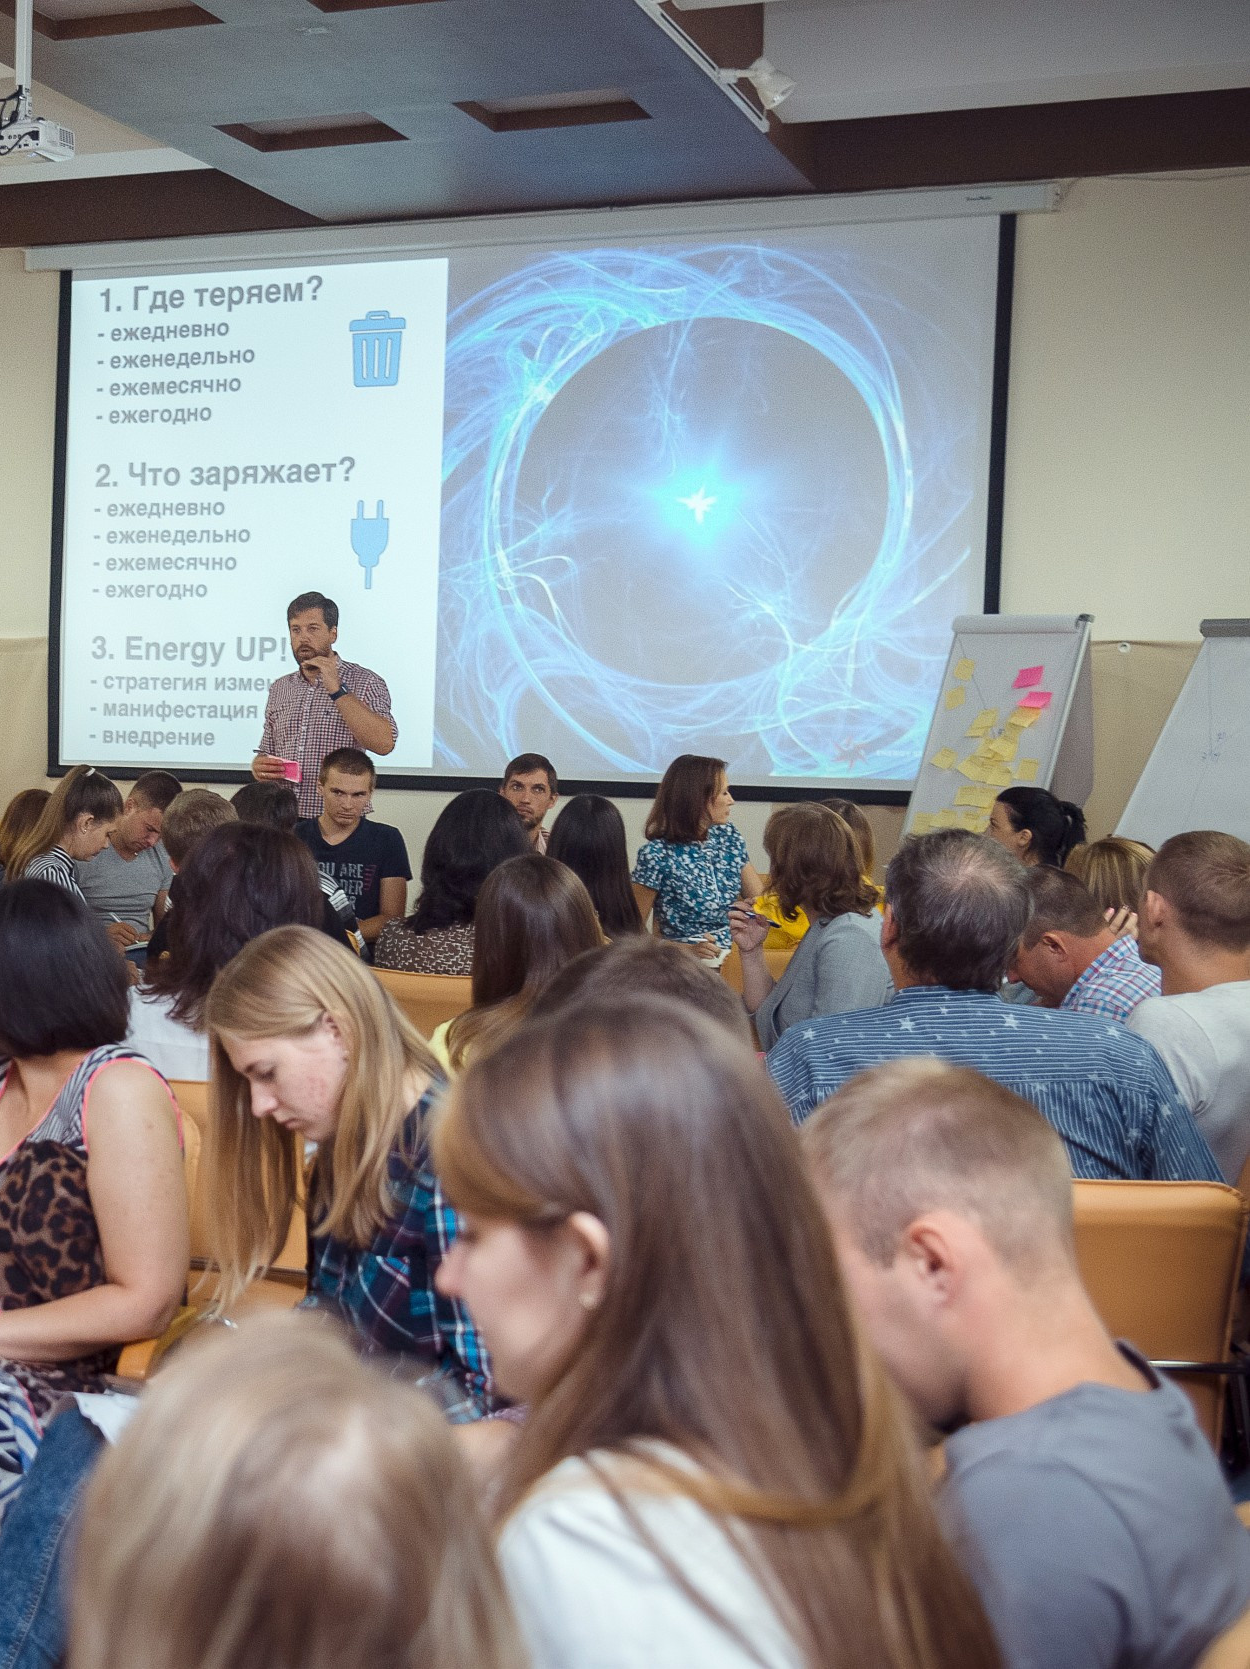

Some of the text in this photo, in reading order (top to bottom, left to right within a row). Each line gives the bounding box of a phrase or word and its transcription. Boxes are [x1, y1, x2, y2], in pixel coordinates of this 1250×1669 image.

[100, 275, 323, 314] 1. Где теряем?
[111, 322, 229, 342] ежедневно
[110, 349, 255, 369] еженедельно
[110, 378, 241, 396] ежемесячно
[109, 407, 212, 425] ежегодно
[96, 456, 355, 491] 2. Что заряжает?
[107, 502, 225, 518] ежедневно
[107, 529, 251, 545] еженедельно
[106, 557, 237, 571] ежемесячно
[105, 584, 208, 600] ежегодно
[92, 636, 286, 667] 3. Energy UP!
[103, 676, 207, 694] стратегия
[103, 700, 258, 722] манифестация
[103, 730, 215, 749] внедрение
[318, 862, 363, 878] OU ARE
[340, 879, 363, 895] DER
